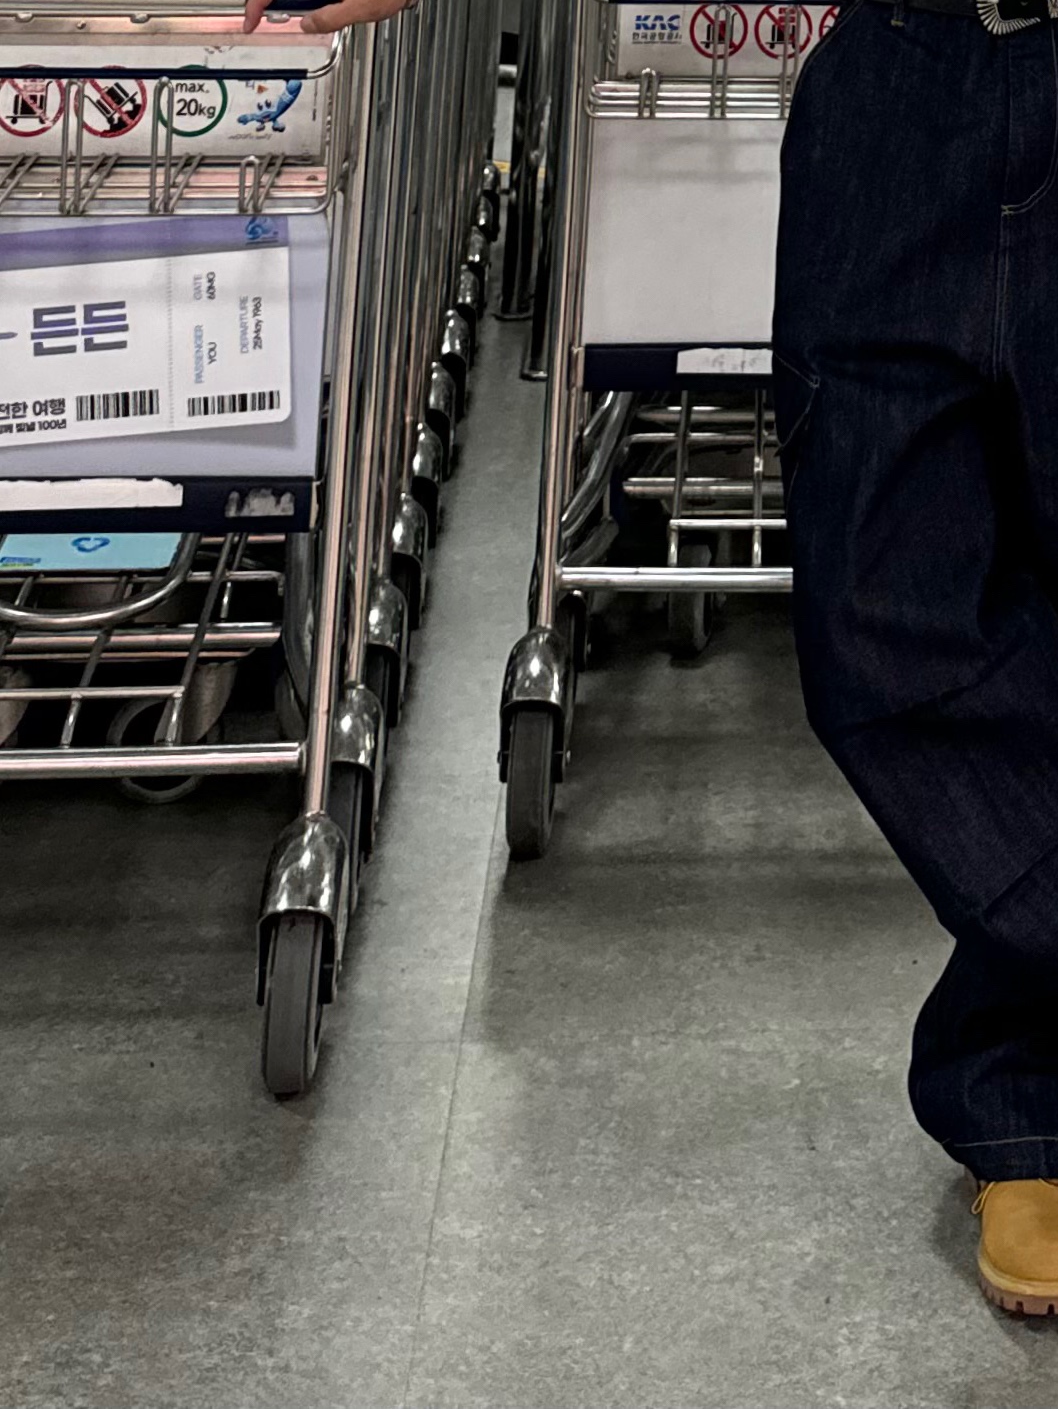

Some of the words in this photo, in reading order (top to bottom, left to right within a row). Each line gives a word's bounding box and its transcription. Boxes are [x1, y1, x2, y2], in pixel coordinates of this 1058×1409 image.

[635, 14, 681, 31] KAC
[174, 81, 210, 93] max.
[175, 98, 217, 118] 20kg
[30, 300, 130, 357] 든든
[239, 296, 250, 354] DEPARTURE
[206, 341, 217, 365] YOU
[32, 397, 66, 417] 여행
